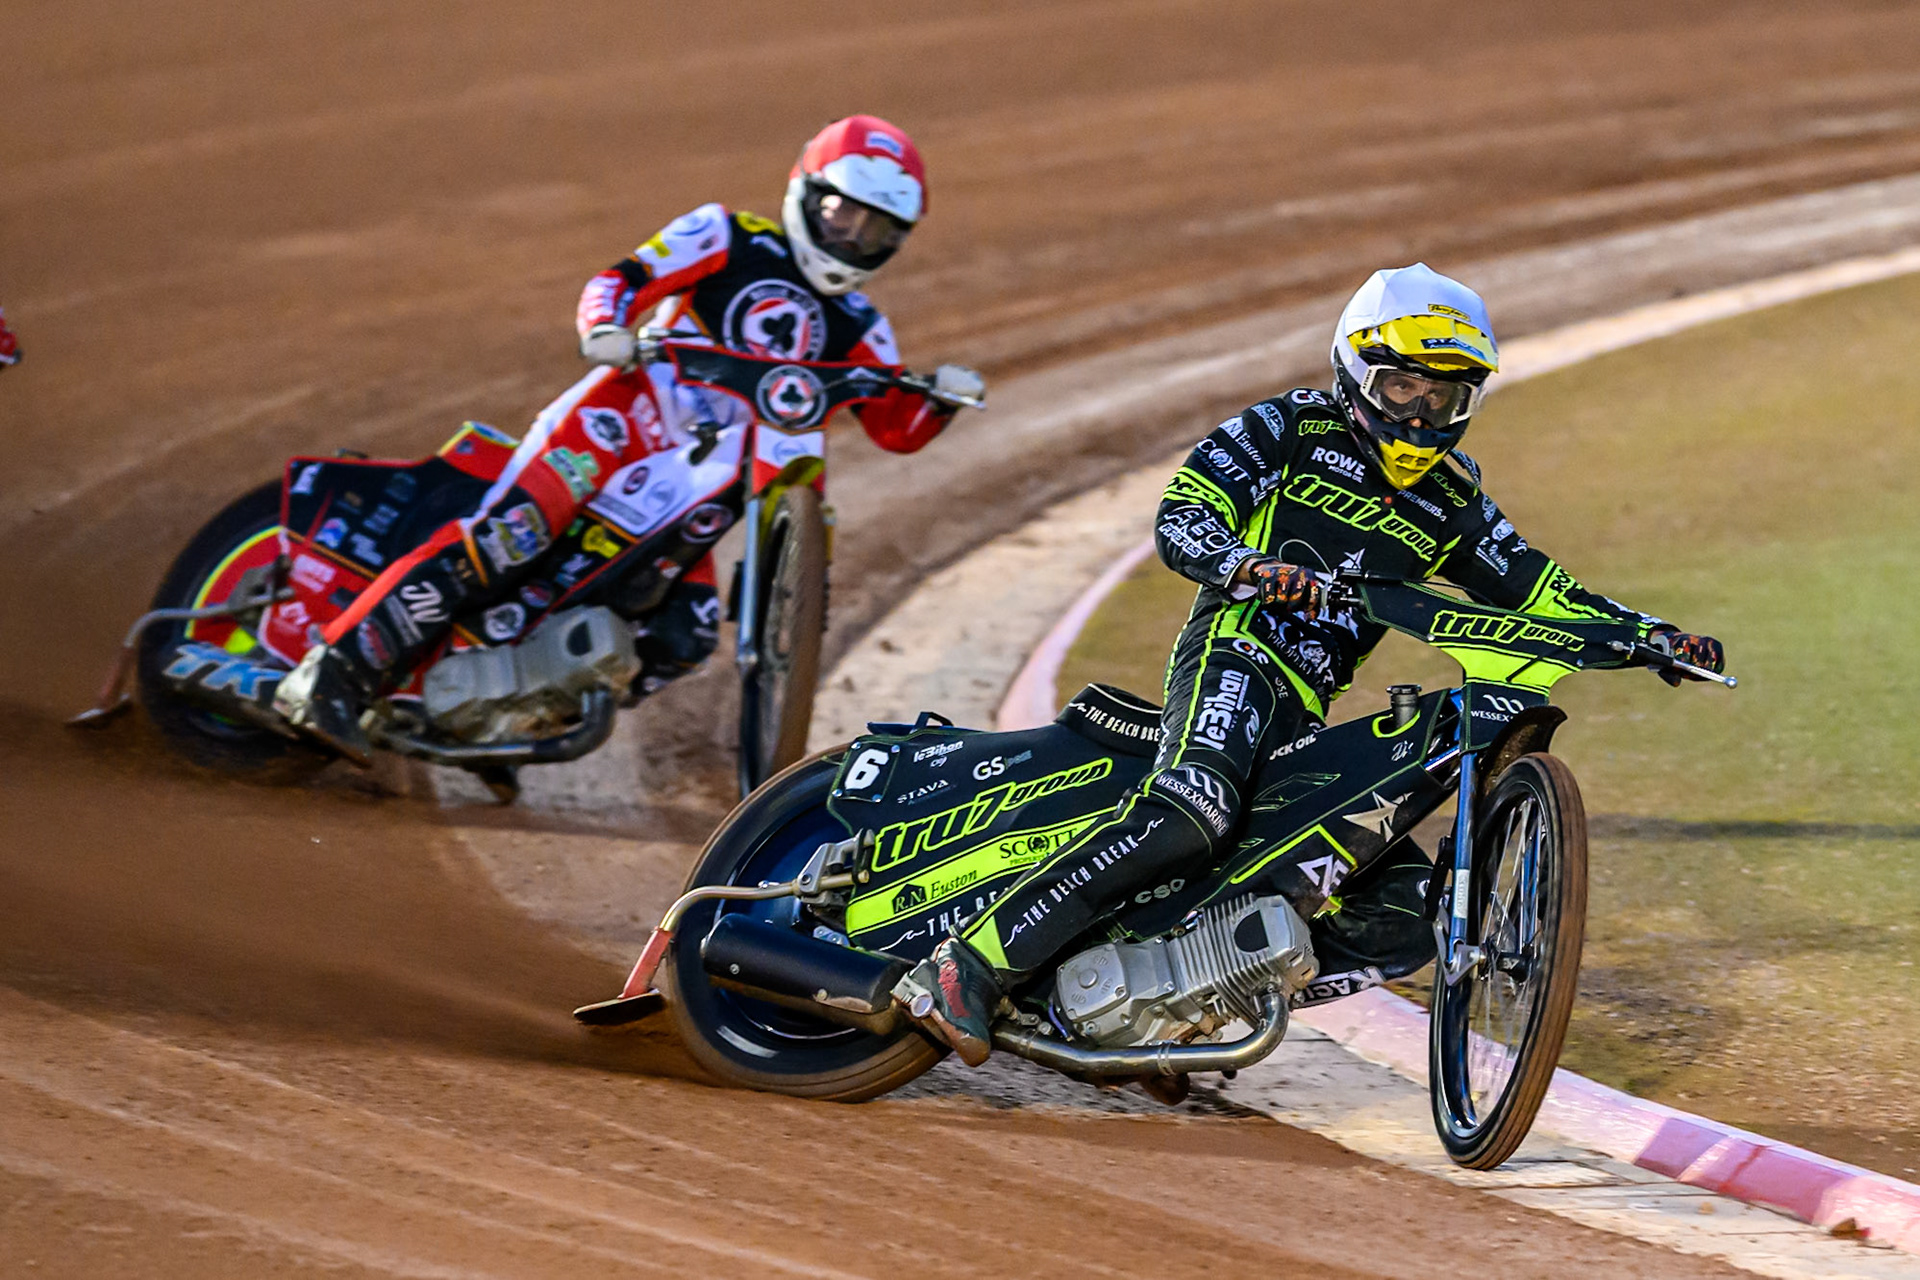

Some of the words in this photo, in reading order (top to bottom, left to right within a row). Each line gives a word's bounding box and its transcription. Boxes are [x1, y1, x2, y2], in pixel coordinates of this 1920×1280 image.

[1196, 437, 1251, 482] COTT
[1311, 446, 1366, 477] ROWE
[1085, 706, 1106, 726] THE
[1106, 714, 1141, 741] BEACH
[1140, 727, 1160, 742] BRE
[1470, 710, 1513, 723] WESSEX
[844, 748, 889, 791] 6
[897, 779, 949, 804] STAVA
[999, 827, 1077, 860] SCOTT
[930, 869, 978, 901] Euston
[1022, 899, 1051, 928] THE
[1053, 861, 1092, 903] BEACH
[1091, 834, 1139, 872] BREAK
[927, 905, 962, 937] THE
[1304, 966, 1385, 999] RACI
